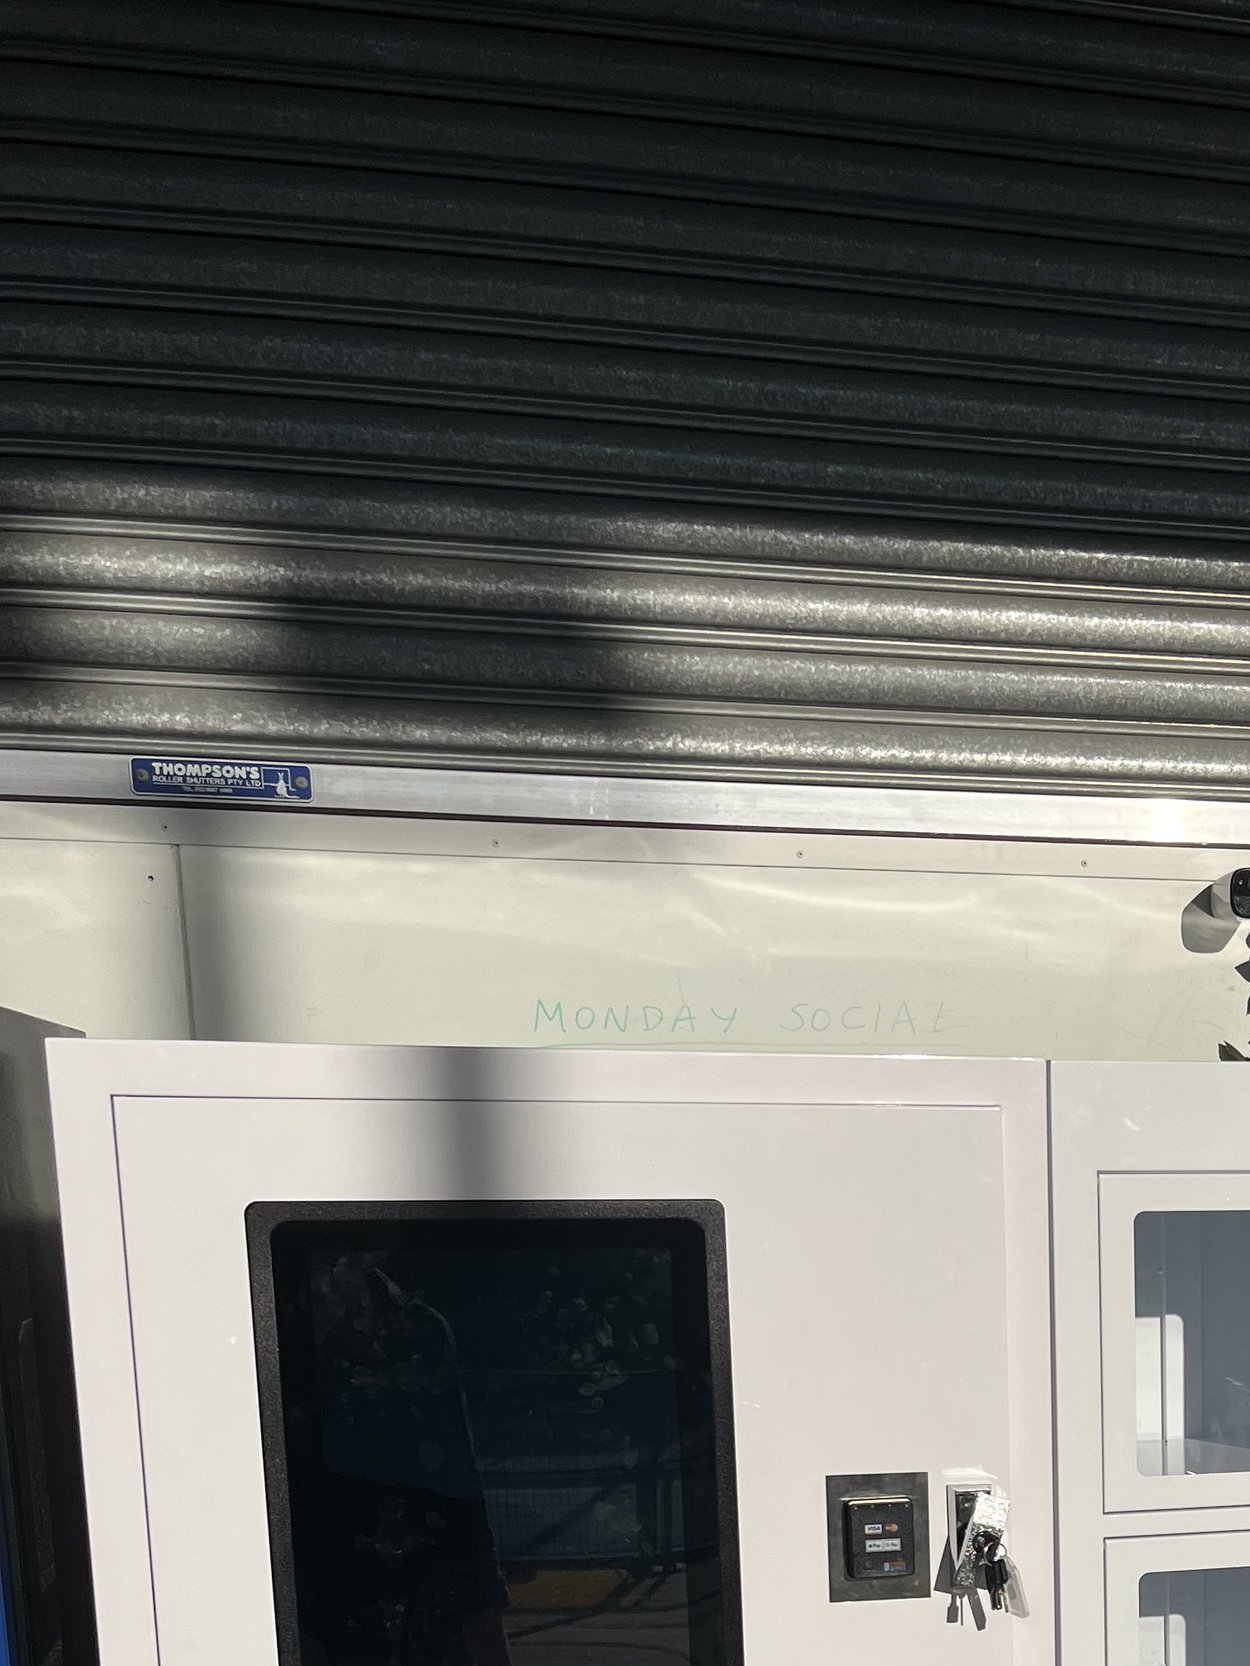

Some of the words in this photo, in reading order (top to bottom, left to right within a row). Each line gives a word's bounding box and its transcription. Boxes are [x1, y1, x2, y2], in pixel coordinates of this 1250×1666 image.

[152, 762, 260, 779] THOMPSON'S
[153, 775, 184, 784] ROLLER
[186, 776, 226, 785] SHUTTERS
[227, 778, 243, 786] PTY
[245, 779, 261, 787] LTD
[534, 999, 738, 1033] MONDAY
